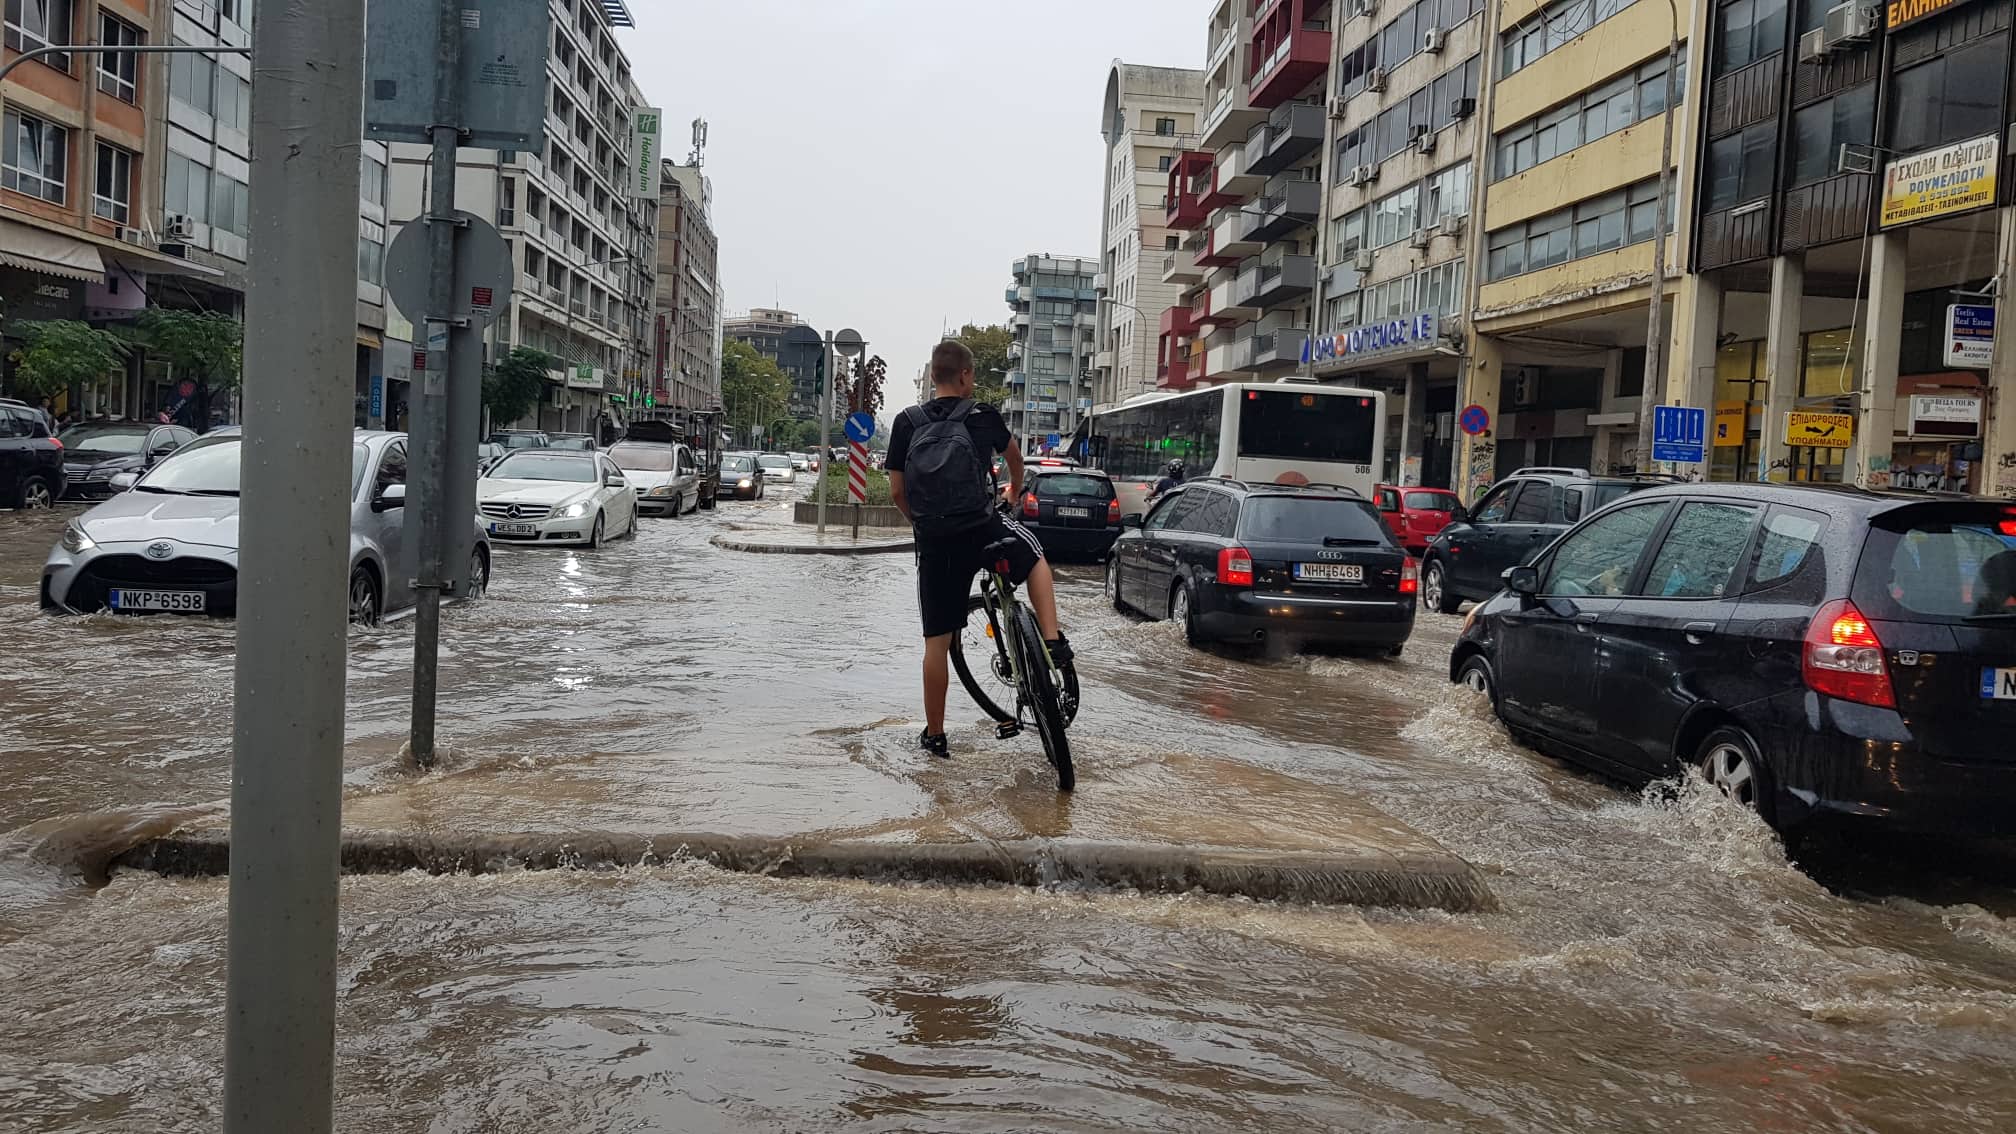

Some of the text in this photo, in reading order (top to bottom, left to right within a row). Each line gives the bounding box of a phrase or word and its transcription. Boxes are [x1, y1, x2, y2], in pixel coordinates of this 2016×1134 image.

[639, 136, 652, 191] Holiday Inn
[1790, 436, 1849, 446] ΥΠΟΔΗΜΑΤΩΝ
